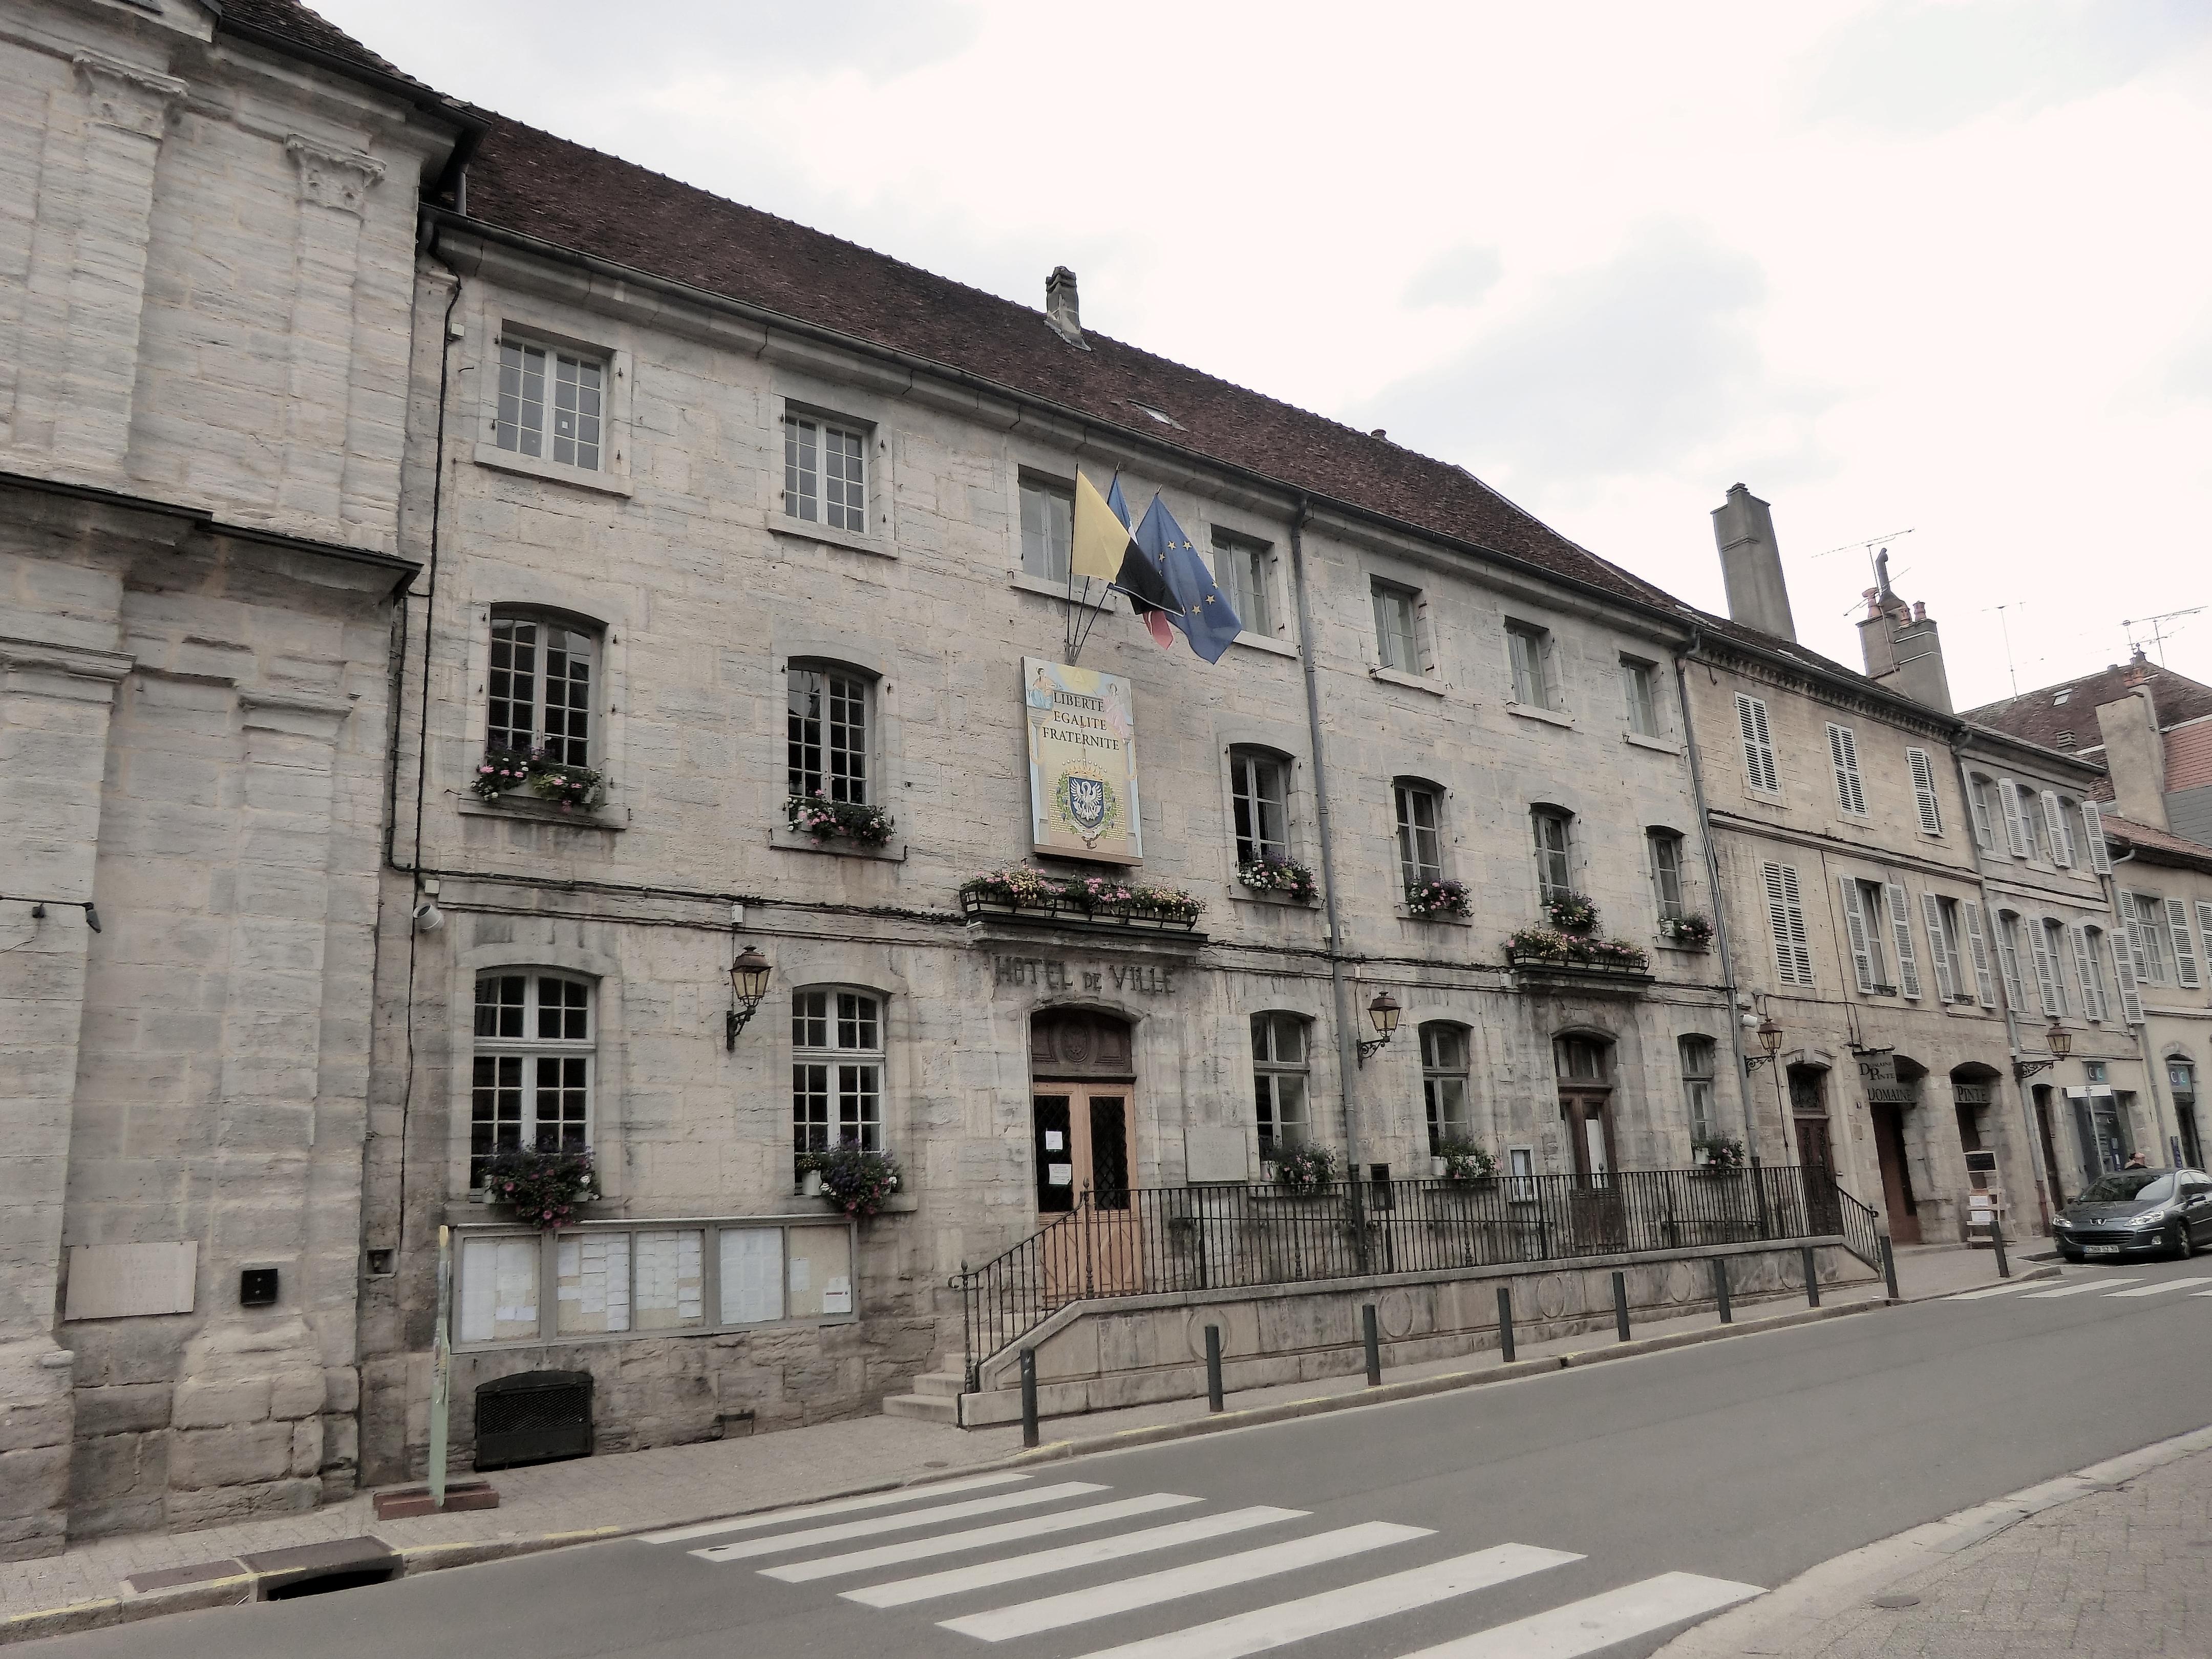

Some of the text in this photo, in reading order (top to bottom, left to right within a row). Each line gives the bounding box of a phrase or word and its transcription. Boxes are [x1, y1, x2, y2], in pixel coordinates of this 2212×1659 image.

[1054, 710, 1107, 731] EGALITE
[1042, 727, 1119, 751] FRATERNITE
[1109, 965, 1175, 995] VILLE
[1955, 1086, 1987, 1101] PINTE
